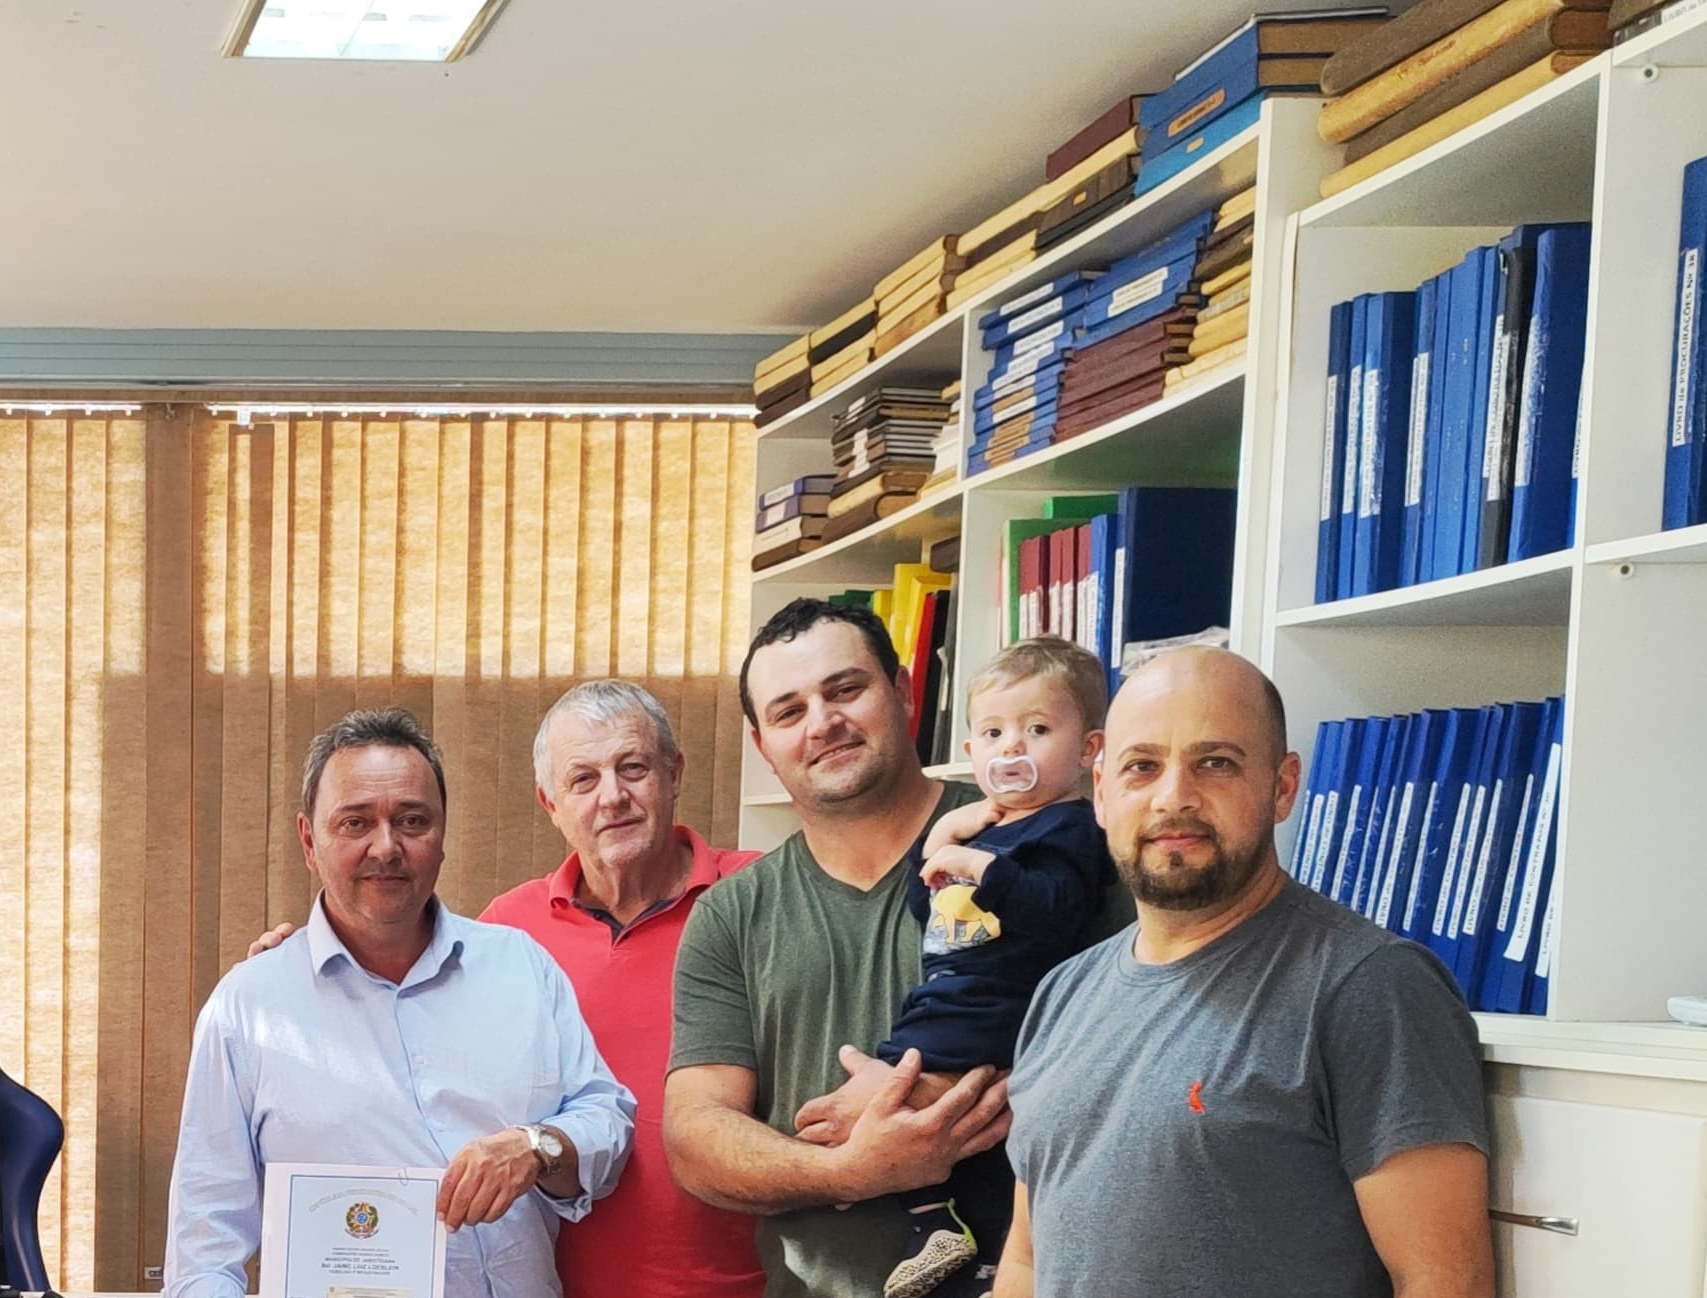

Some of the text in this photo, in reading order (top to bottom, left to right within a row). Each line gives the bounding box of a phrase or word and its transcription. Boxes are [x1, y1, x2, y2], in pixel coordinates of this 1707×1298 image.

[1676, 291, 1693, 384] PROCURAÇÕES
[1677, 386, 1685, 401] de
[1674, 404, 1684, 442] LIVRO
